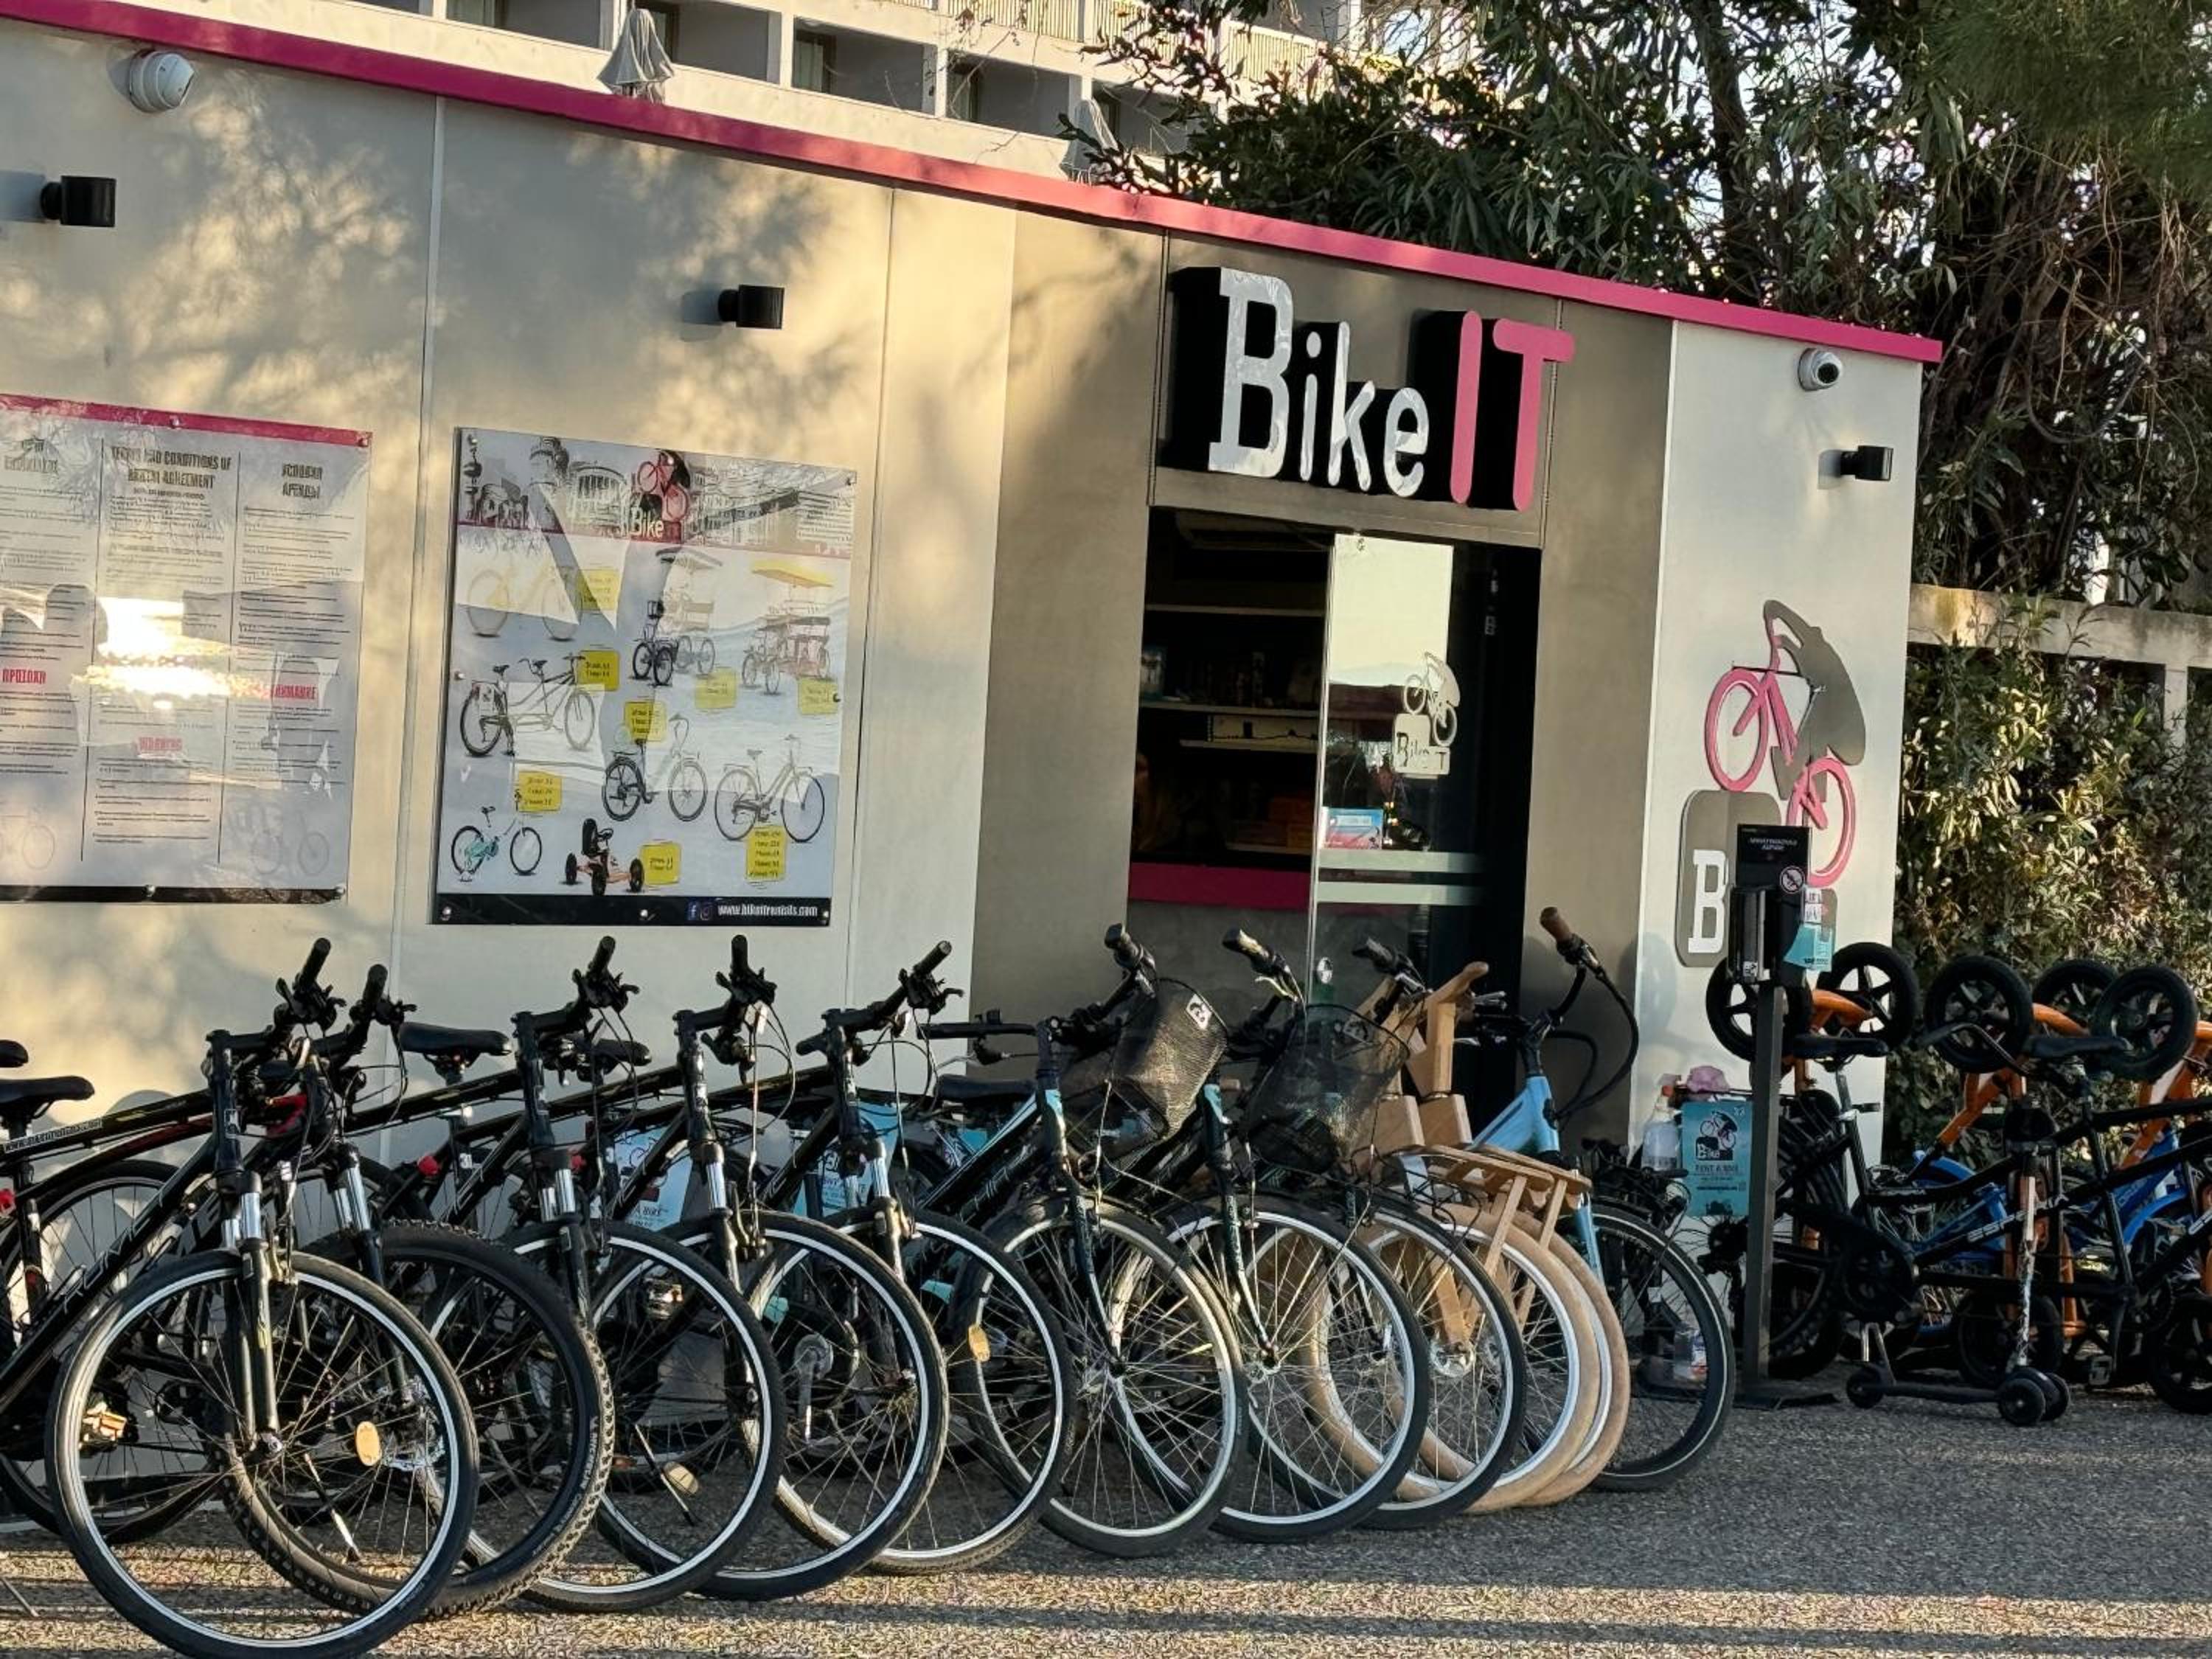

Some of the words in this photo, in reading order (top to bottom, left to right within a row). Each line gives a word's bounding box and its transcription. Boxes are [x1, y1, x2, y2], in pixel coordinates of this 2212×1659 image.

[1208, 267, 1430, 498] Bike
[1450, 310, 1576, 512] IT
[164, 451, 219, 470] CONDITIONS
[220, 456, 232, 470] OF
[164, 470, 215, 489] AGREEMENT
[630, 507, 664, 538] Bike
